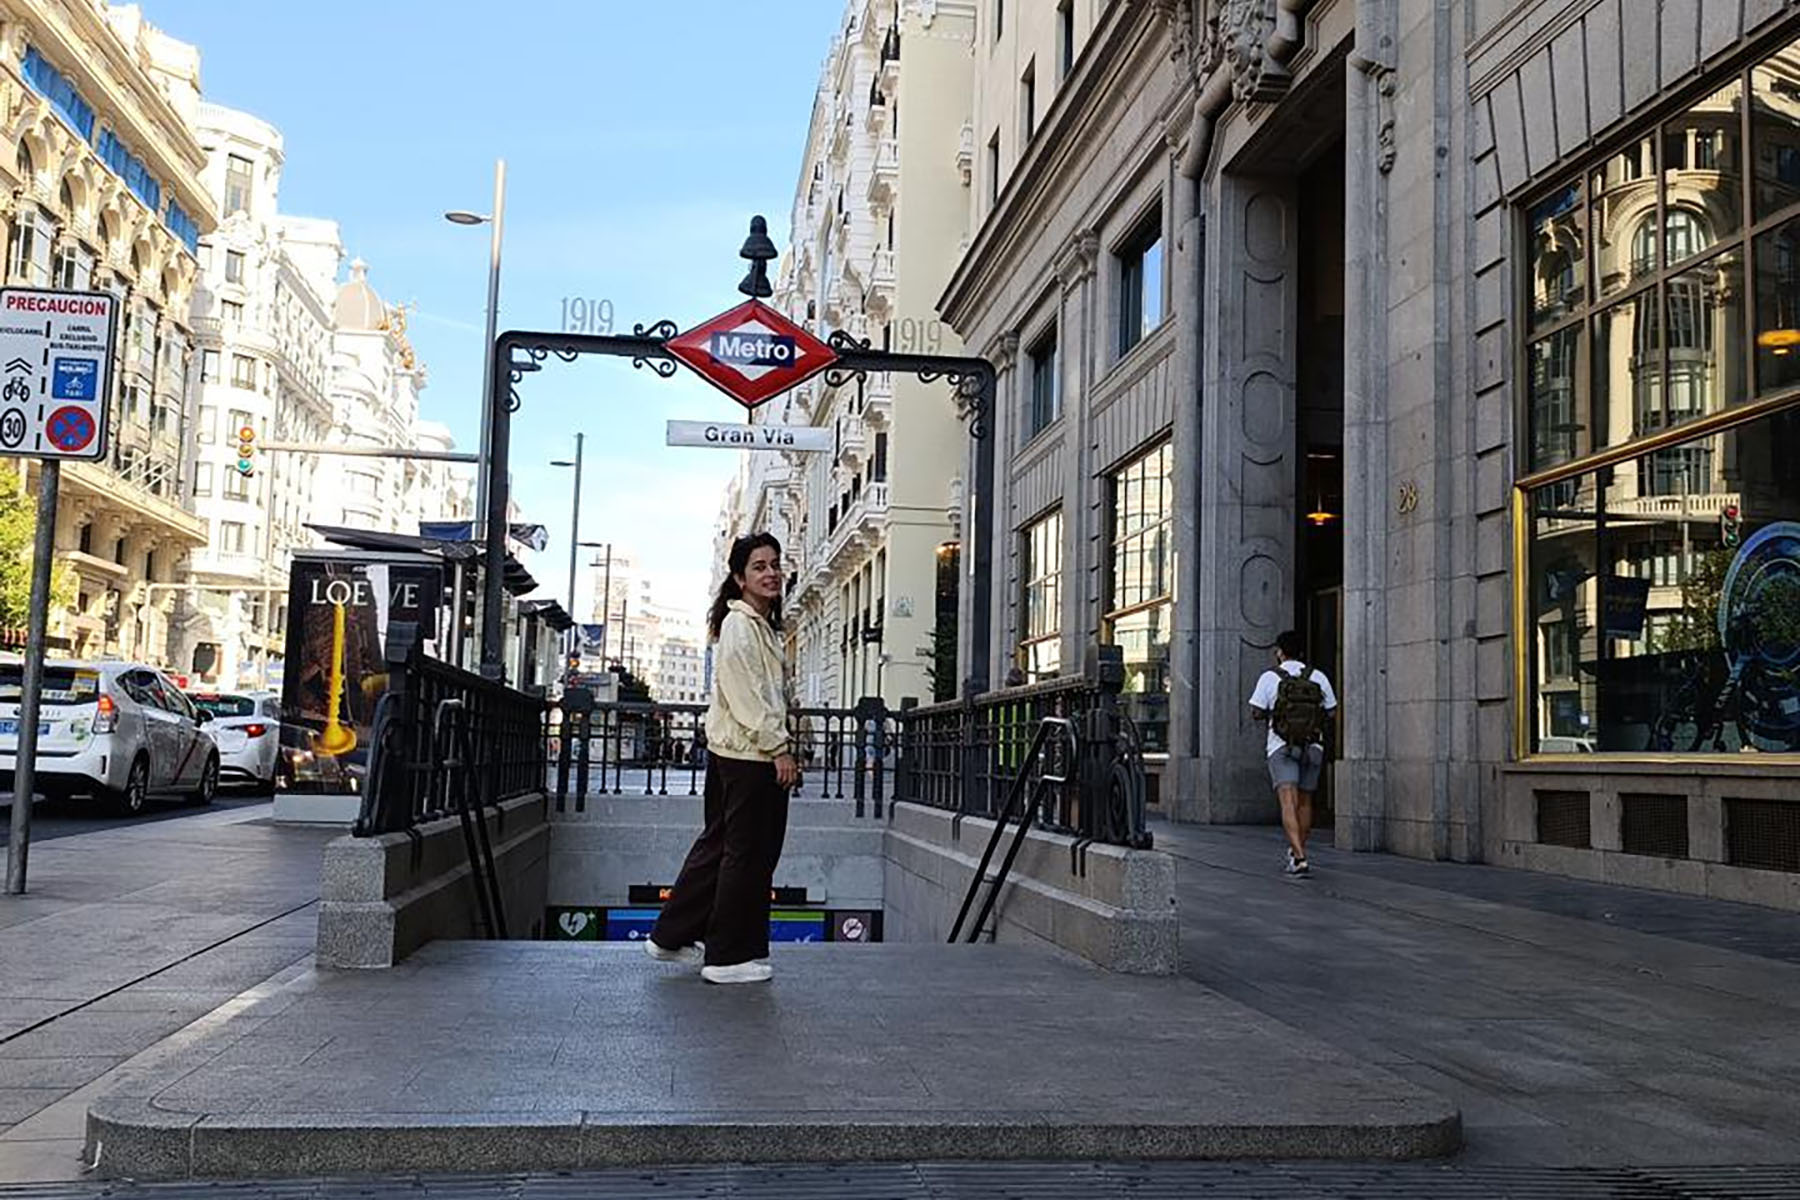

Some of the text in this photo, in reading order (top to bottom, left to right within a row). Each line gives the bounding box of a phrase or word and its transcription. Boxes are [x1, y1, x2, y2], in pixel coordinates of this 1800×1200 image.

[561, 296, 614, 333] 1919
[718, 335, 790, 361] Metro
[892, 317, 942, 353] 1919
[4, 417, 21, 438] 30
[704, 426, 754, 444] Gran
